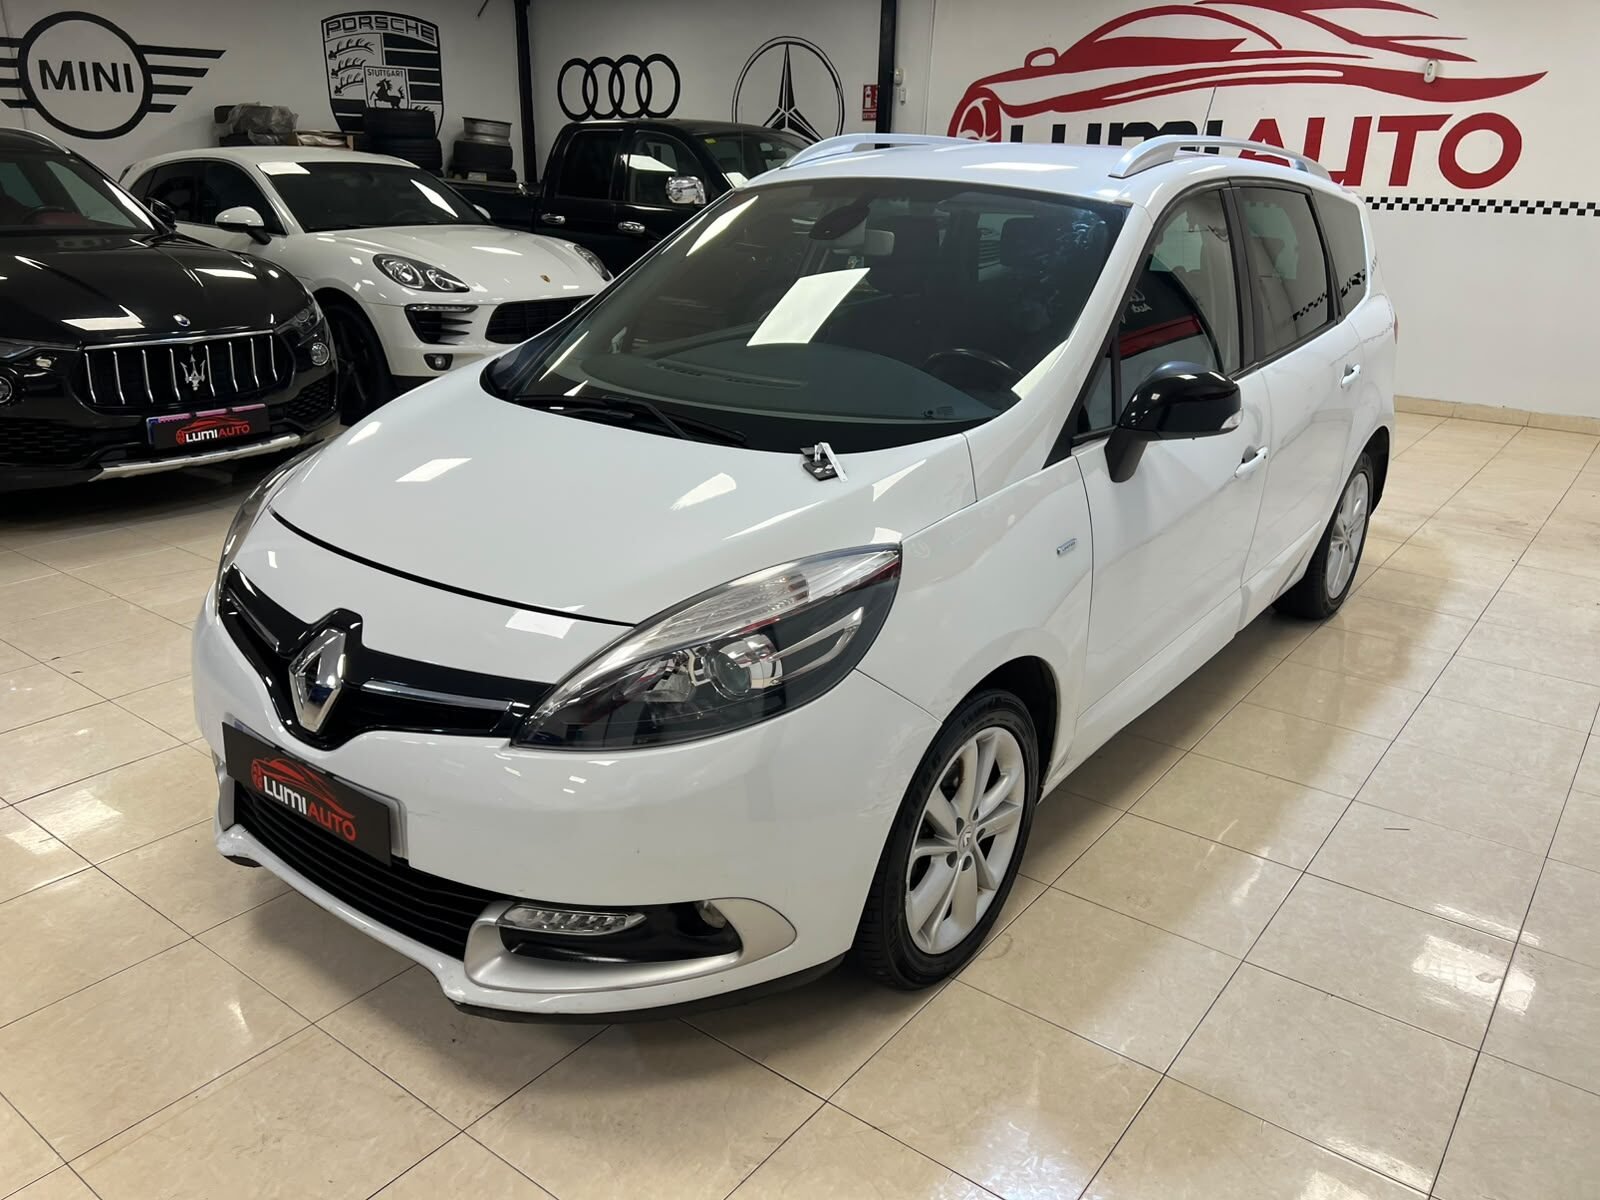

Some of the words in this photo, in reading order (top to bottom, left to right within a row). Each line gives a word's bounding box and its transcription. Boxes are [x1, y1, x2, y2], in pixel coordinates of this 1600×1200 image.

[325, 15, 435, 42] PORSCHE
[38, 59, 135, 94] MINI
[367, 68, 404, 78] STUTTGART
[1010, 111, 1523, 190] AUTO
